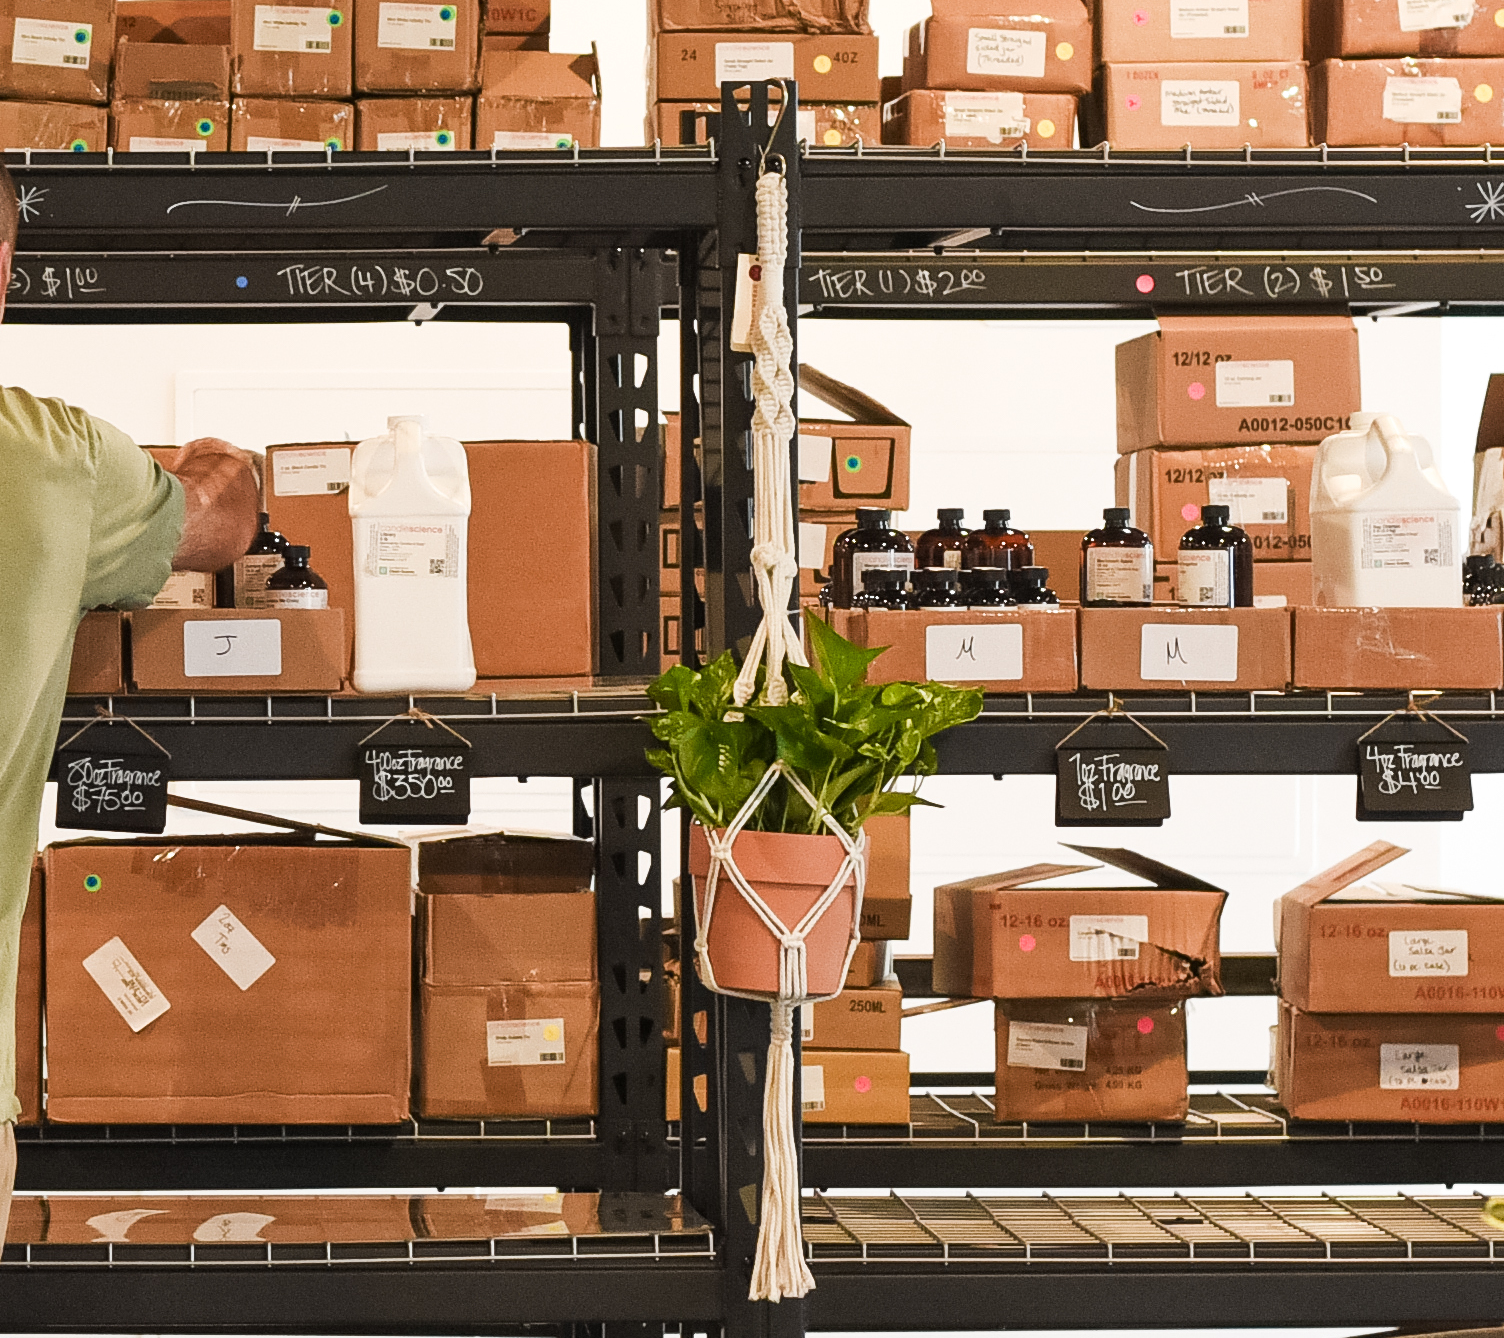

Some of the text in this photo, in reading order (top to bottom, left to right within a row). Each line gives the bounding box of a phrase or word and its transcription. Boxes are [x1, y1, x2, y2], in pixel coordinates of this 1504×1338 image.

[681, 50, 698, 61] 24
[277, 266, 350, 296] TIER
[351, 266, 387, 297] (4)
[810, 269, 872, 299] TIER
[880, 269, 910, 295] (1)
[1174, 267, 1254, 297] TIER
[1263, 267, 1300, 299] (2)
[1172, 353, 1210, 366] 12/12
[1165, 469, 1203, 483] 12/12
[380, 524, 443, 534] candlescience
[1370, 516, 1435, 524] candlescience
[214, 635, 237, 657] J
[956, 636, 975, 661] M
[1166, 637, 1188, 664] M
[105, 759, 161, 788] Fragrance
[403, 749, 463, 779] Fragrance
[1099, 755, 1160, 791] Fragrance
[1396, 746, 1463, 779] Fragrance
[1000, 915, 1043, 928] 12-16
[1320, 925, 1363, 938] 12-16
[850, 1001, 885, 1014] 250ML
